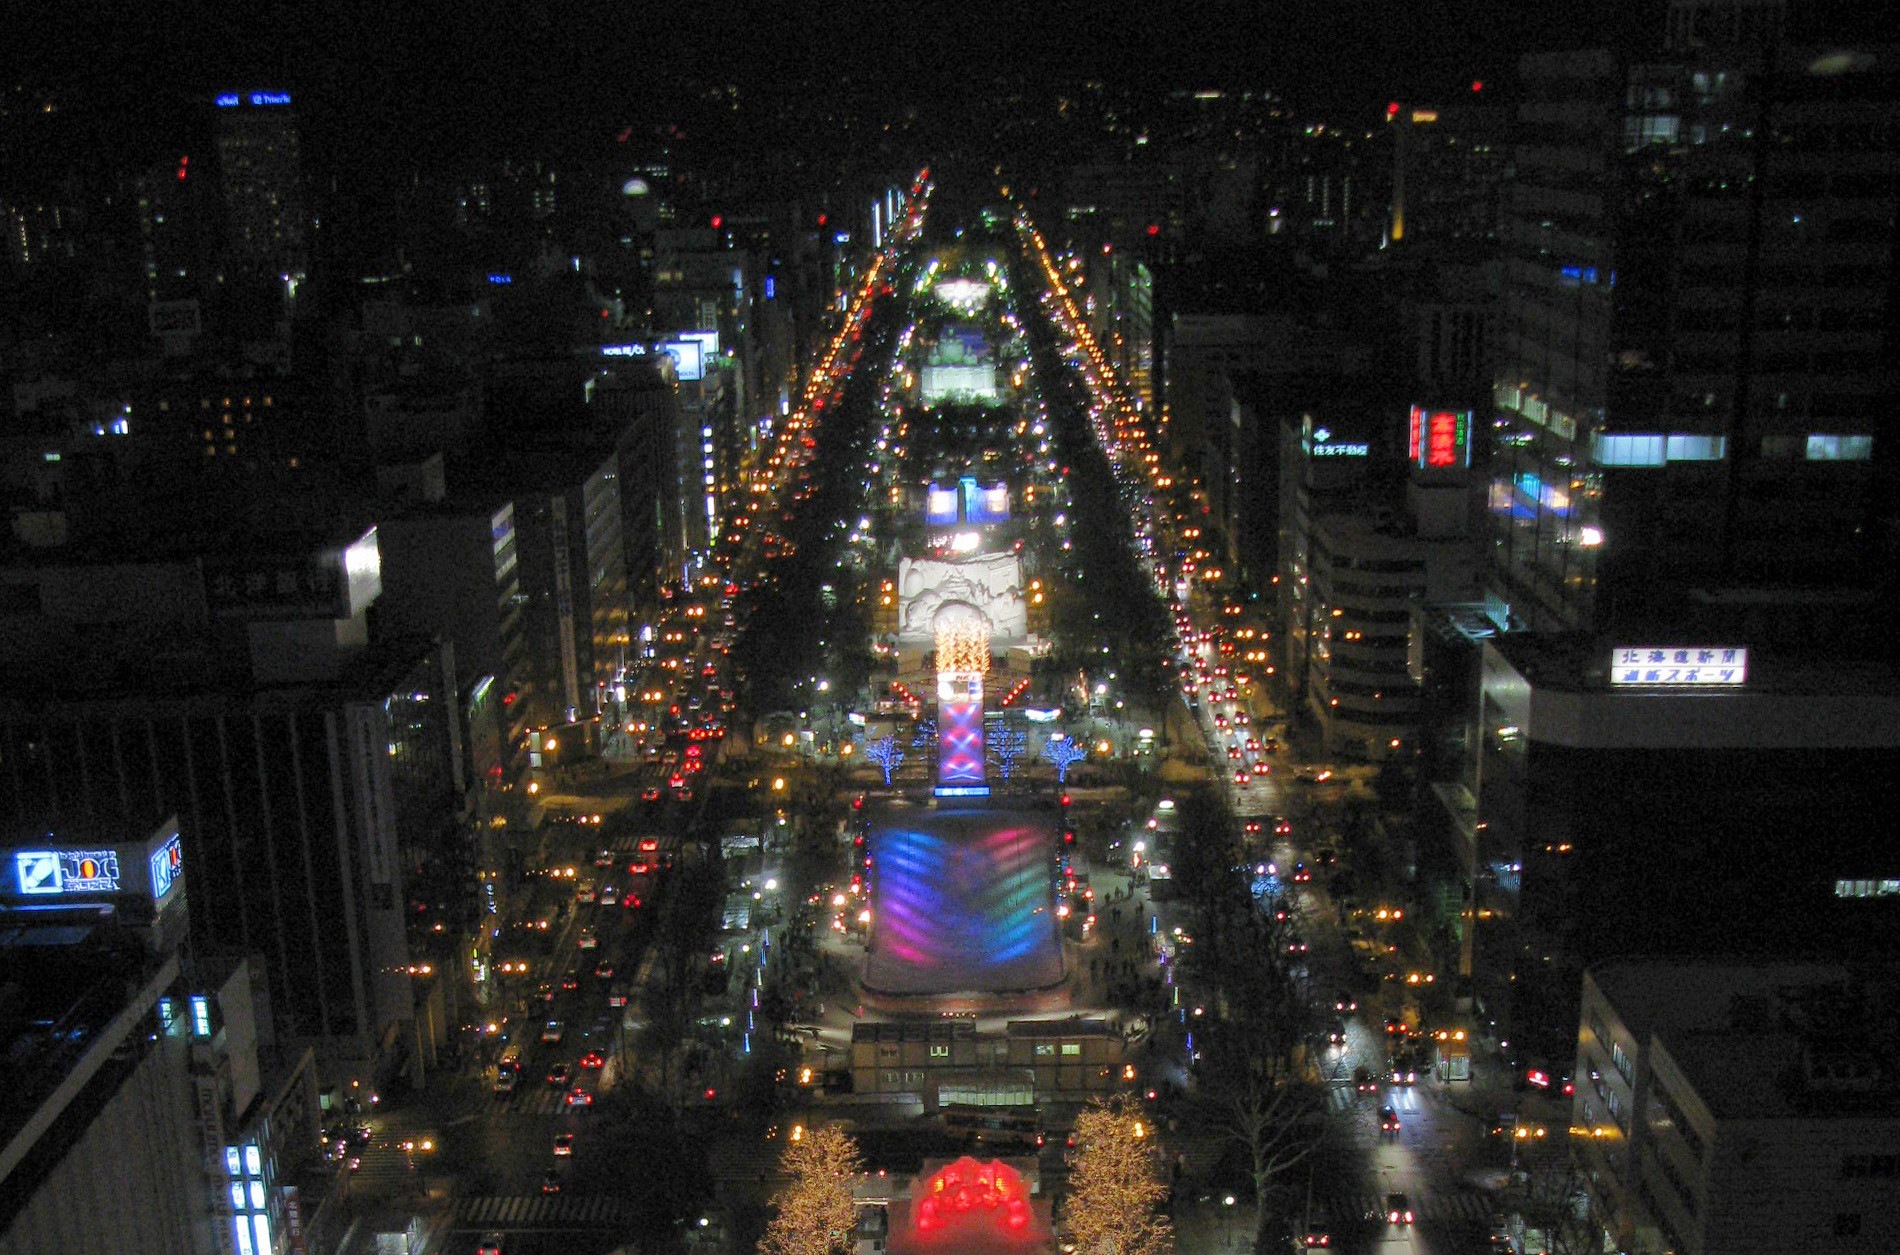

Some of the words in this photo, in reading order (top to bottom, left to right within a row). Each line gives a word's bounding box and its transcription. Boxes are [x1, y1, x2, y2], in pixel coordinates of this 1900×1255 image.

[603, 347, 622, 355] HOTEL
[1313, 443, 1368, 456] 住友不動産
[1622, 650, 1736, 664] 北海道新聞
[1622, 666, 1735, 681] 道新スポーツ
[61, 858, 120, 881] JOG
